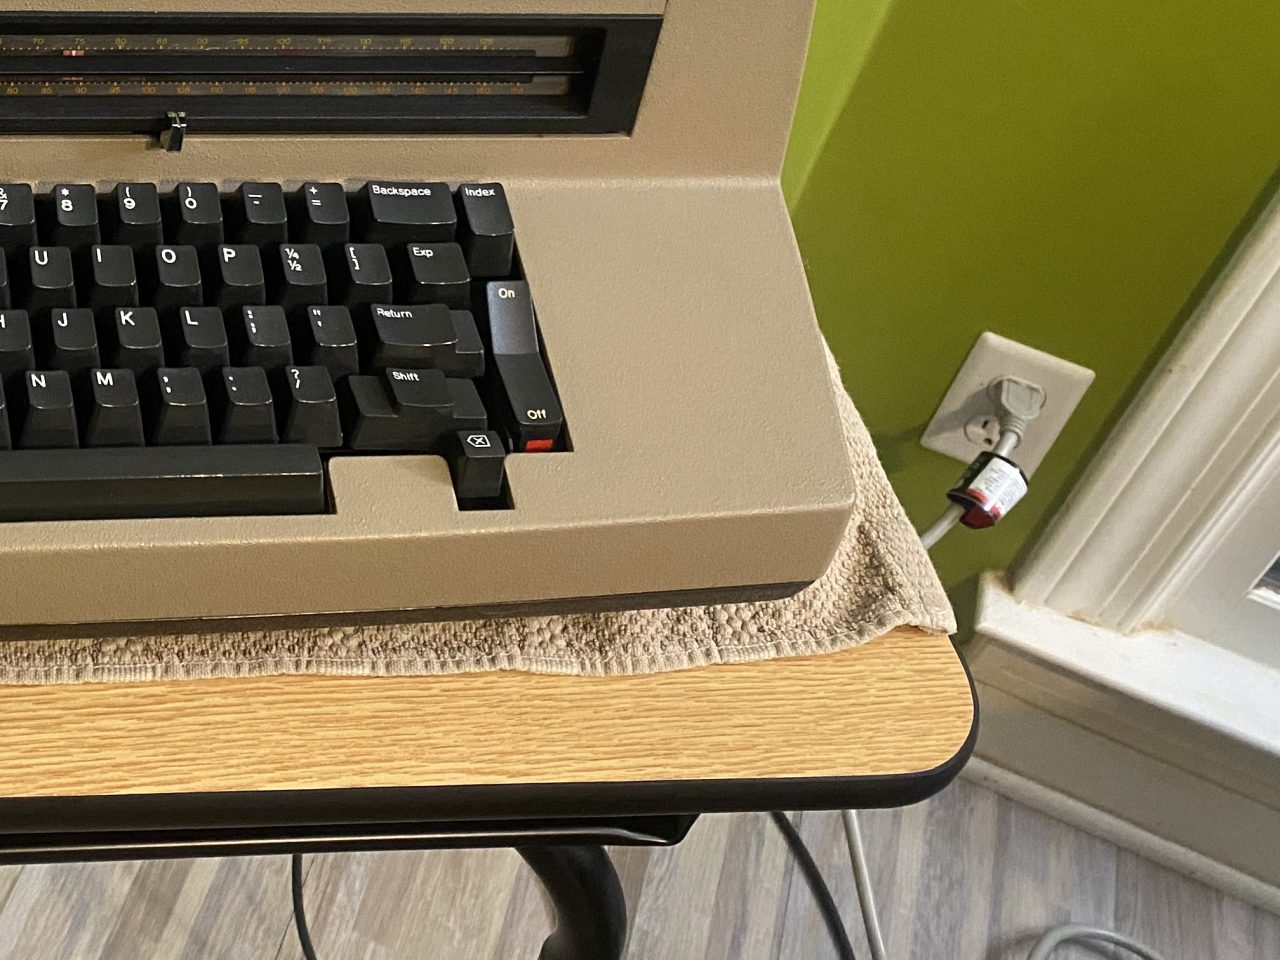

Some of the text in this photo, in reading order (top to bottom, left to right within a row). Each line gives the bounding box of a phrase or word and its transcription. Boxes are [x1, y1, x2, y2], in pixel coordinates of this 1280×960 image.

[372, 185, 431, 197] Backspace
[465, 188, 495, 196] Index
[62, 200, 73, 211] 8
[124, 198, 135, 209] 9
[35, 250, 48, 265] U
[97, 248, 101, 262] I
[162, 249, 176, 263] O
[223, 248, 235, 262] P
[413, 247, 433, 258] Exp
[498, 288, 515, 298] On
[120, 311, 135, 325] K
[185, 311, 198, 325] L
[377, 308, 412, 317] Return
[58, 313, 67, 326] J
[31, 374, 46, 387] N
[97, 372, 113, 385] M
[393, 372, 419, 381] Shift
[527, 410, 546, 419] Off
